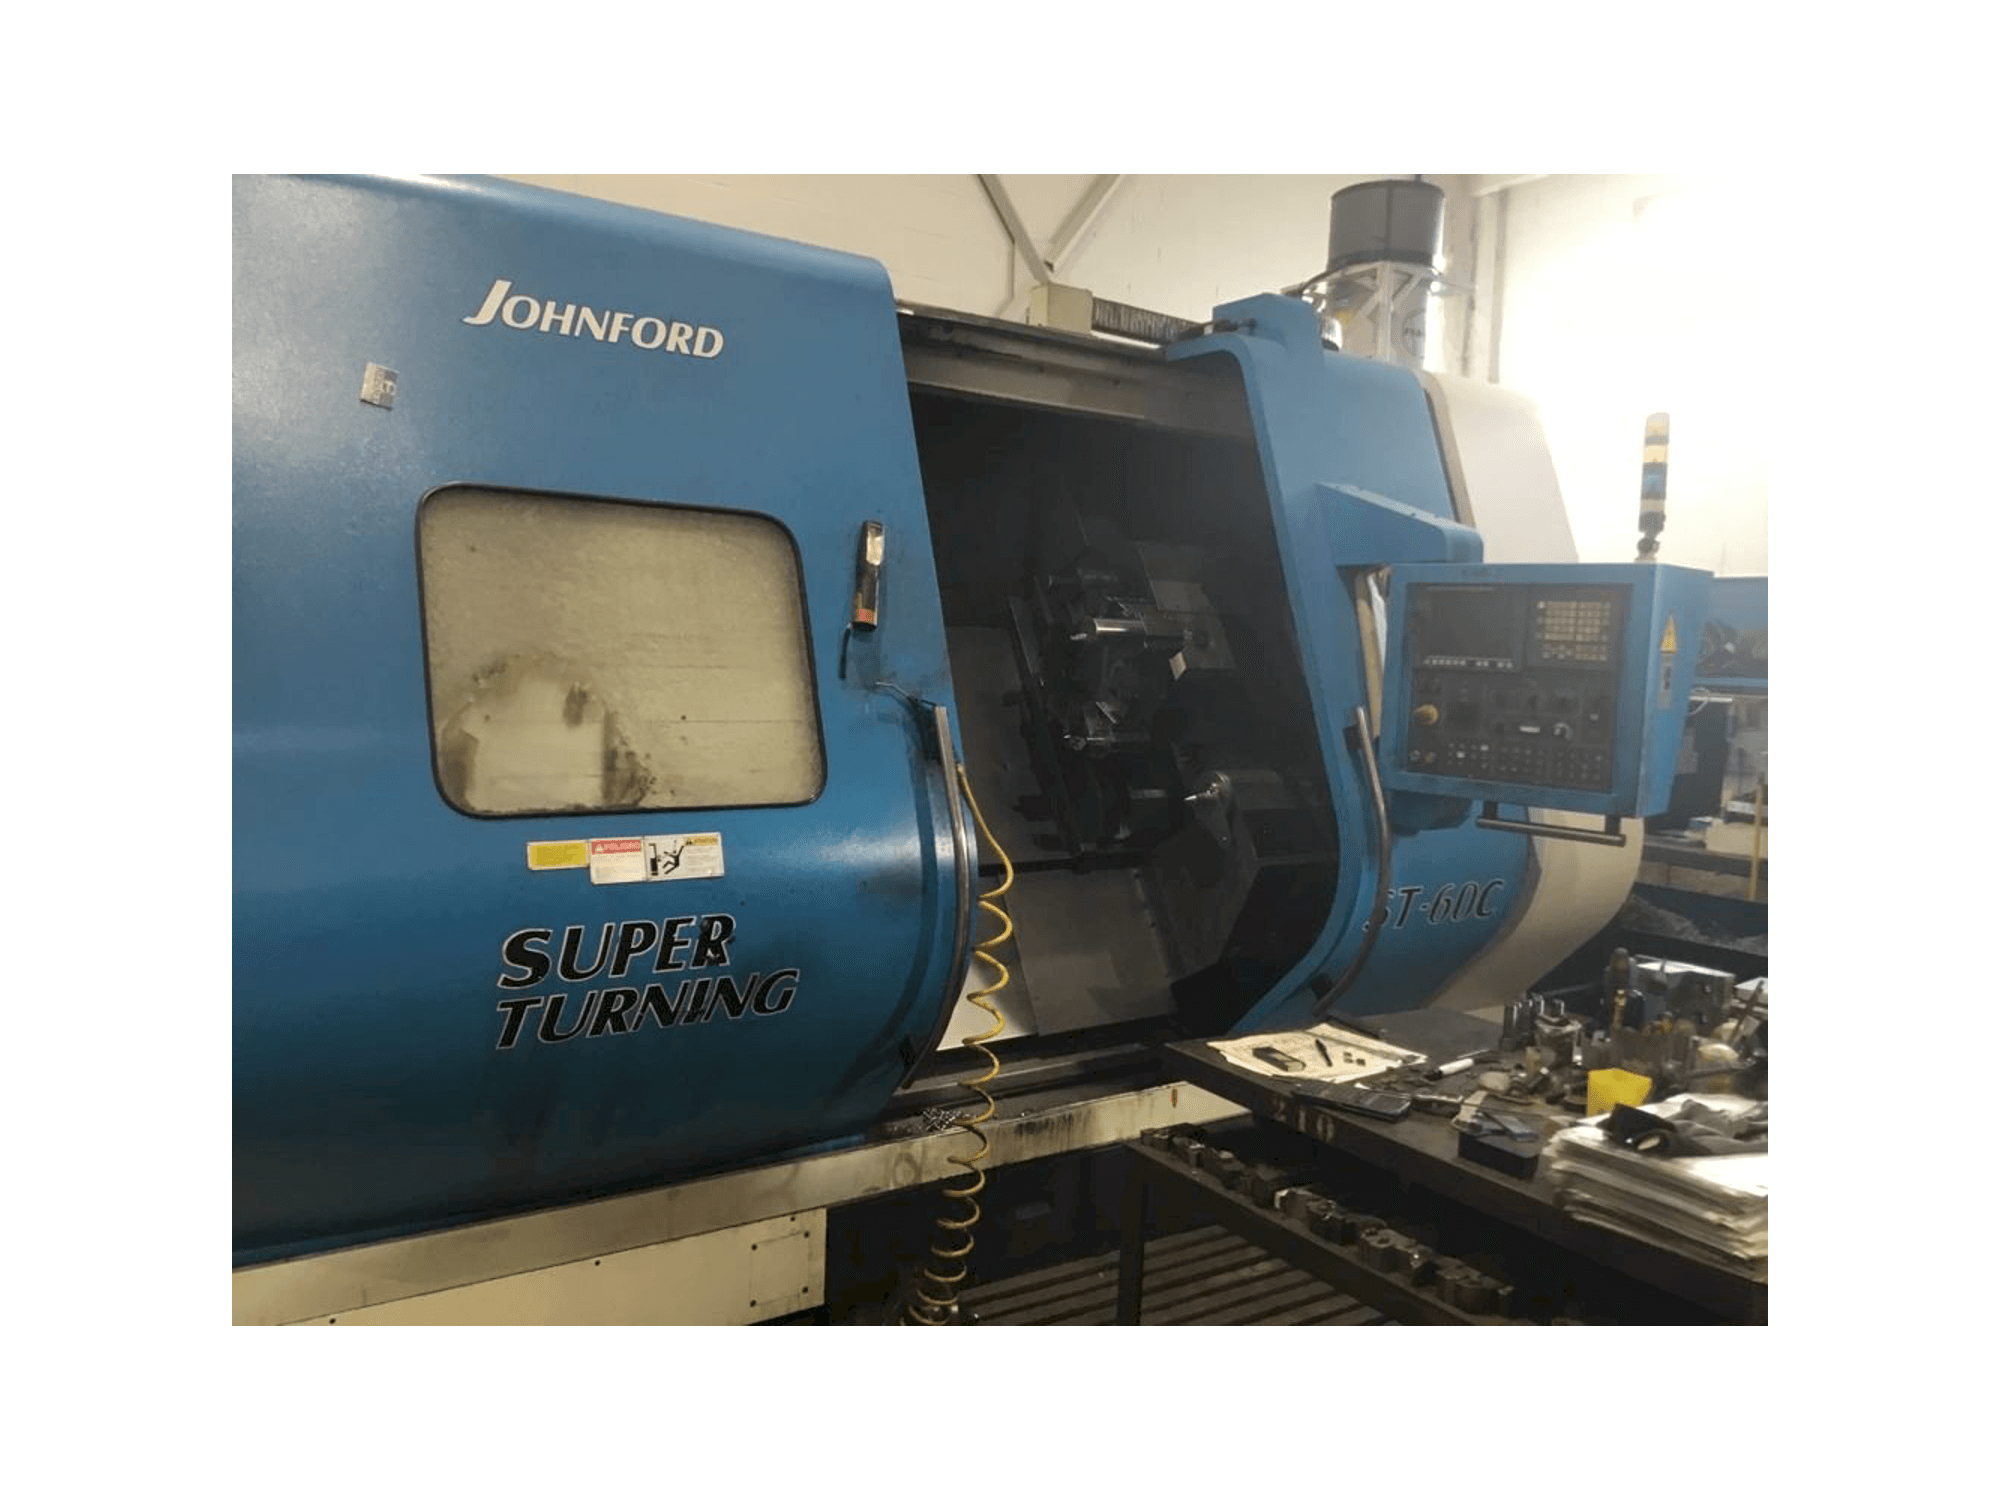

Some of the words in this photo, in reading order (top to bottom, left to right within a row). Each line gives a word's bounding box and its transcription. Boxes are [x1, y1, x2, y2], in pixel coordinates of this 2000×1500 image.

[462, 279, 724, 358] JOHNFORD
[497, 913, 736, 989] SUPER
[496, 968, 799, 1049] TURNING
